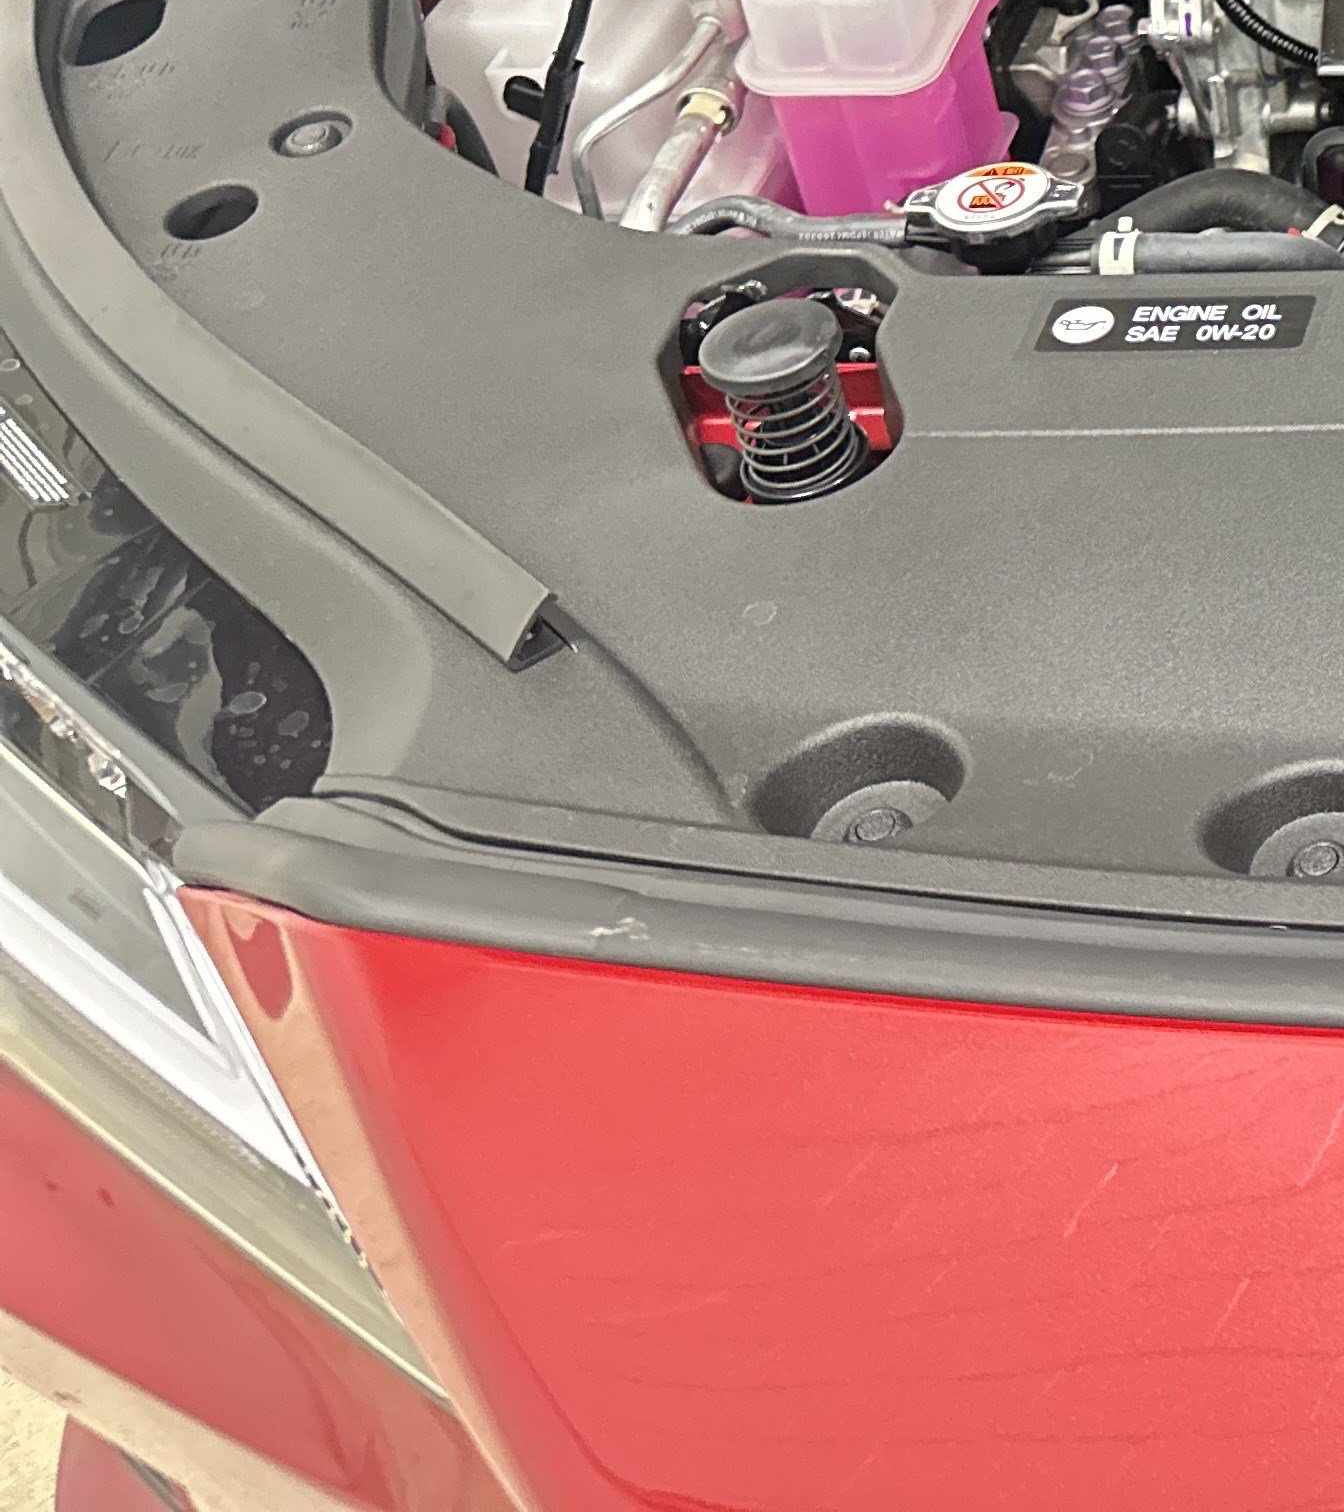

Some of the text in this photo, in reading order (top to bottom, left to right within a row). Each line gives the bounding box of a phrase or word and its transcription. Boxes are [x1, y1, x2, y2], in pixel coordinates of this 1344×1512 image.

[1132, 304, 1282, 322] ENGINE OIL
[1124, 324, 1276, 343] SAE 0W-20
